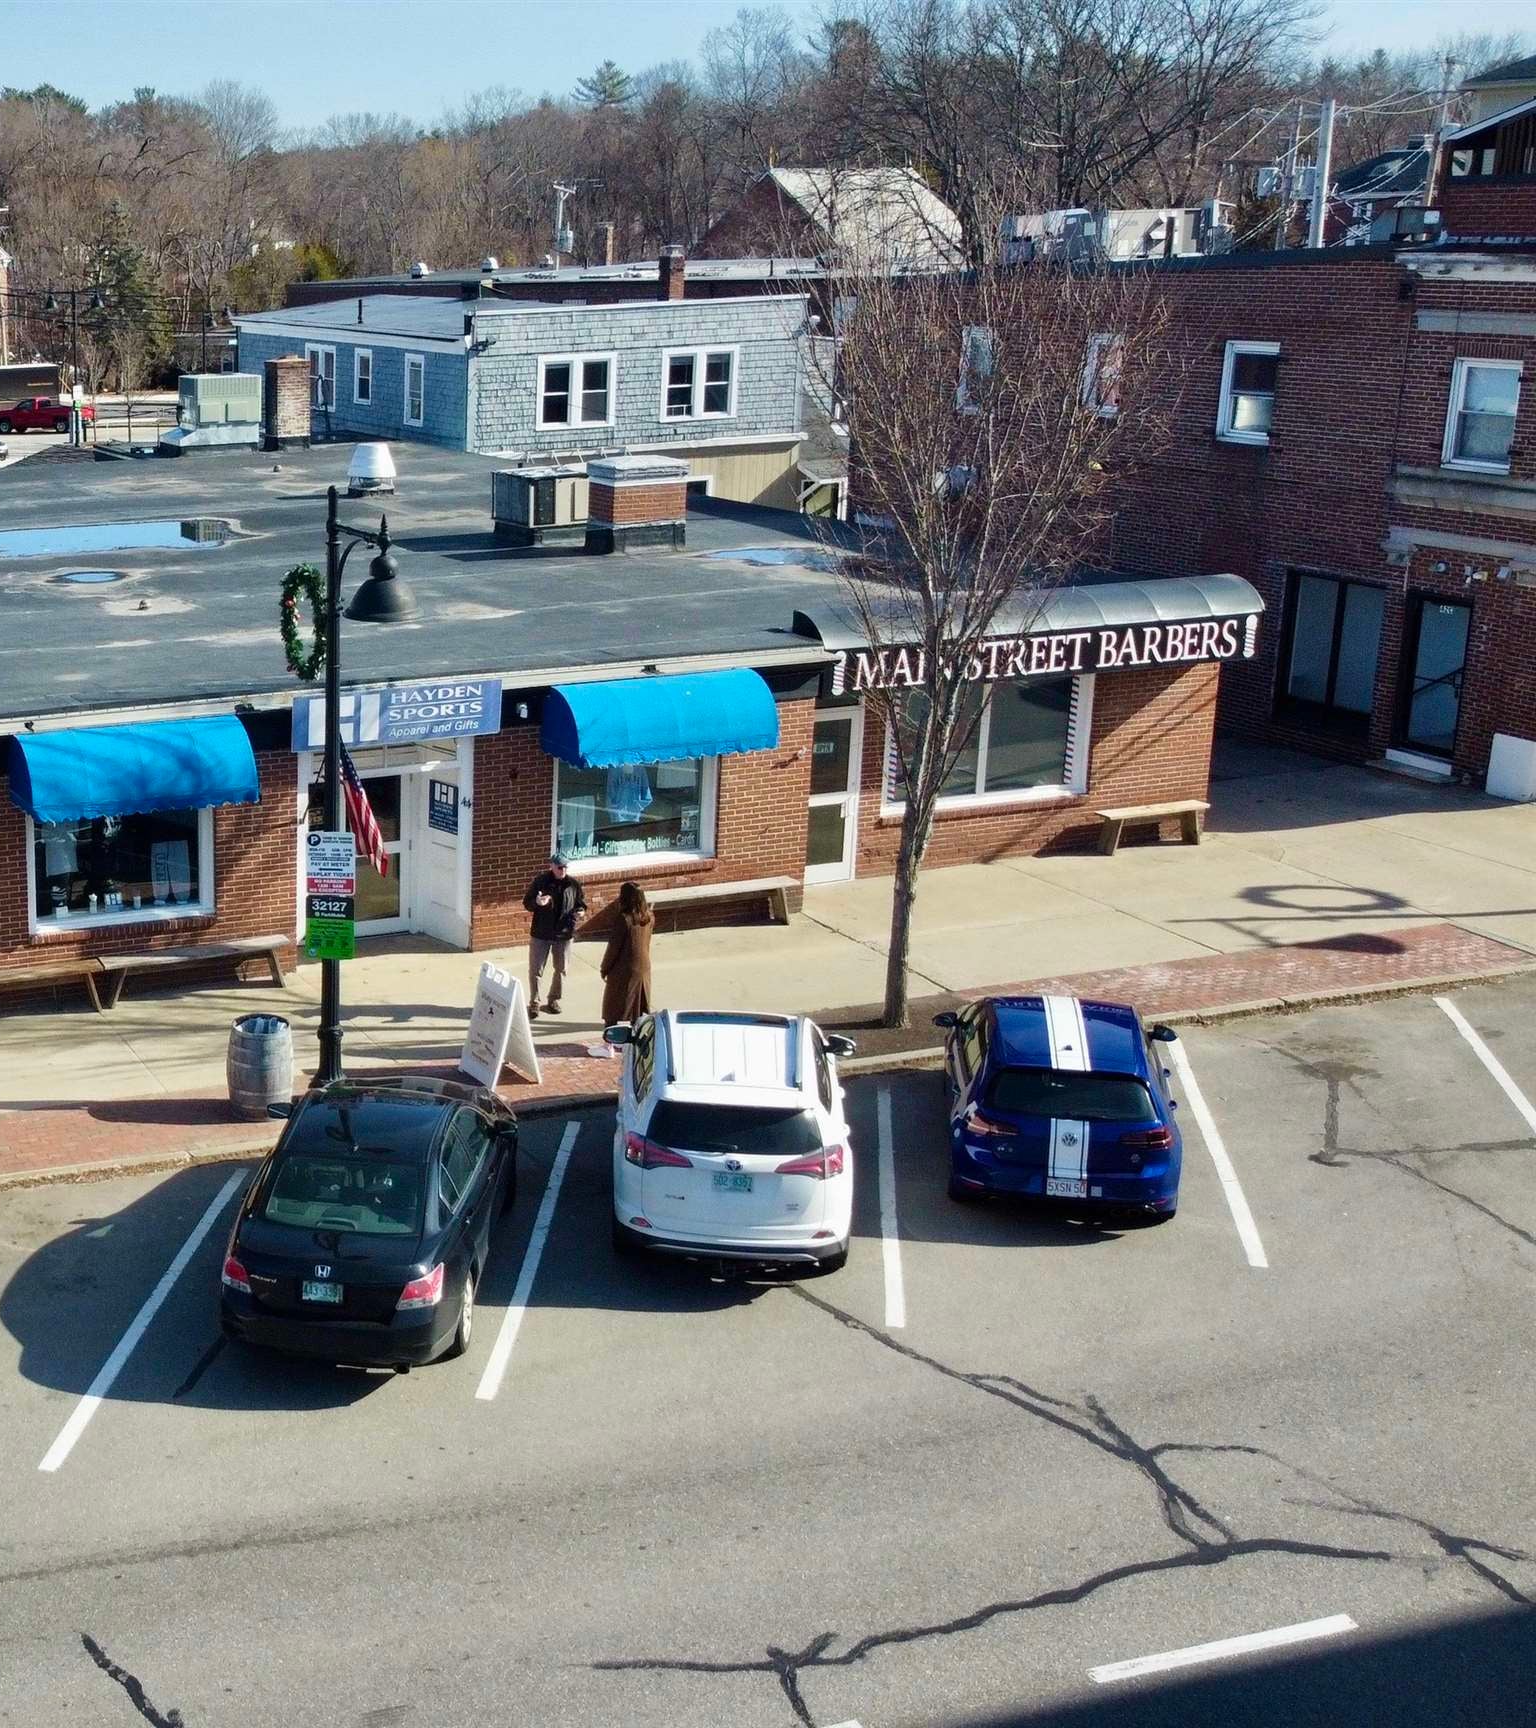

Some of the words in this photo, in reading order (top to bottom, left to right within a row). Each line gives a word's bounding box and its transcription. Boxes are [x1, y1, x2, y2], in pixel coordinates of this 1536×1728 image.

[964, 632, 1092, 680] STREET
[1096, 619, 1239, 669] BARBERS
[390, 684, 482, 704] HAYDEN
[388, 701, 482, 721] SPORTS
[388, 726, 430, 738] Apparel
[432, 723, 451, 733] and
[454, 719, 480, 731] Gifts
[676, 833, 696, 847] Cards
[311, 900, 348, 912] 32127
